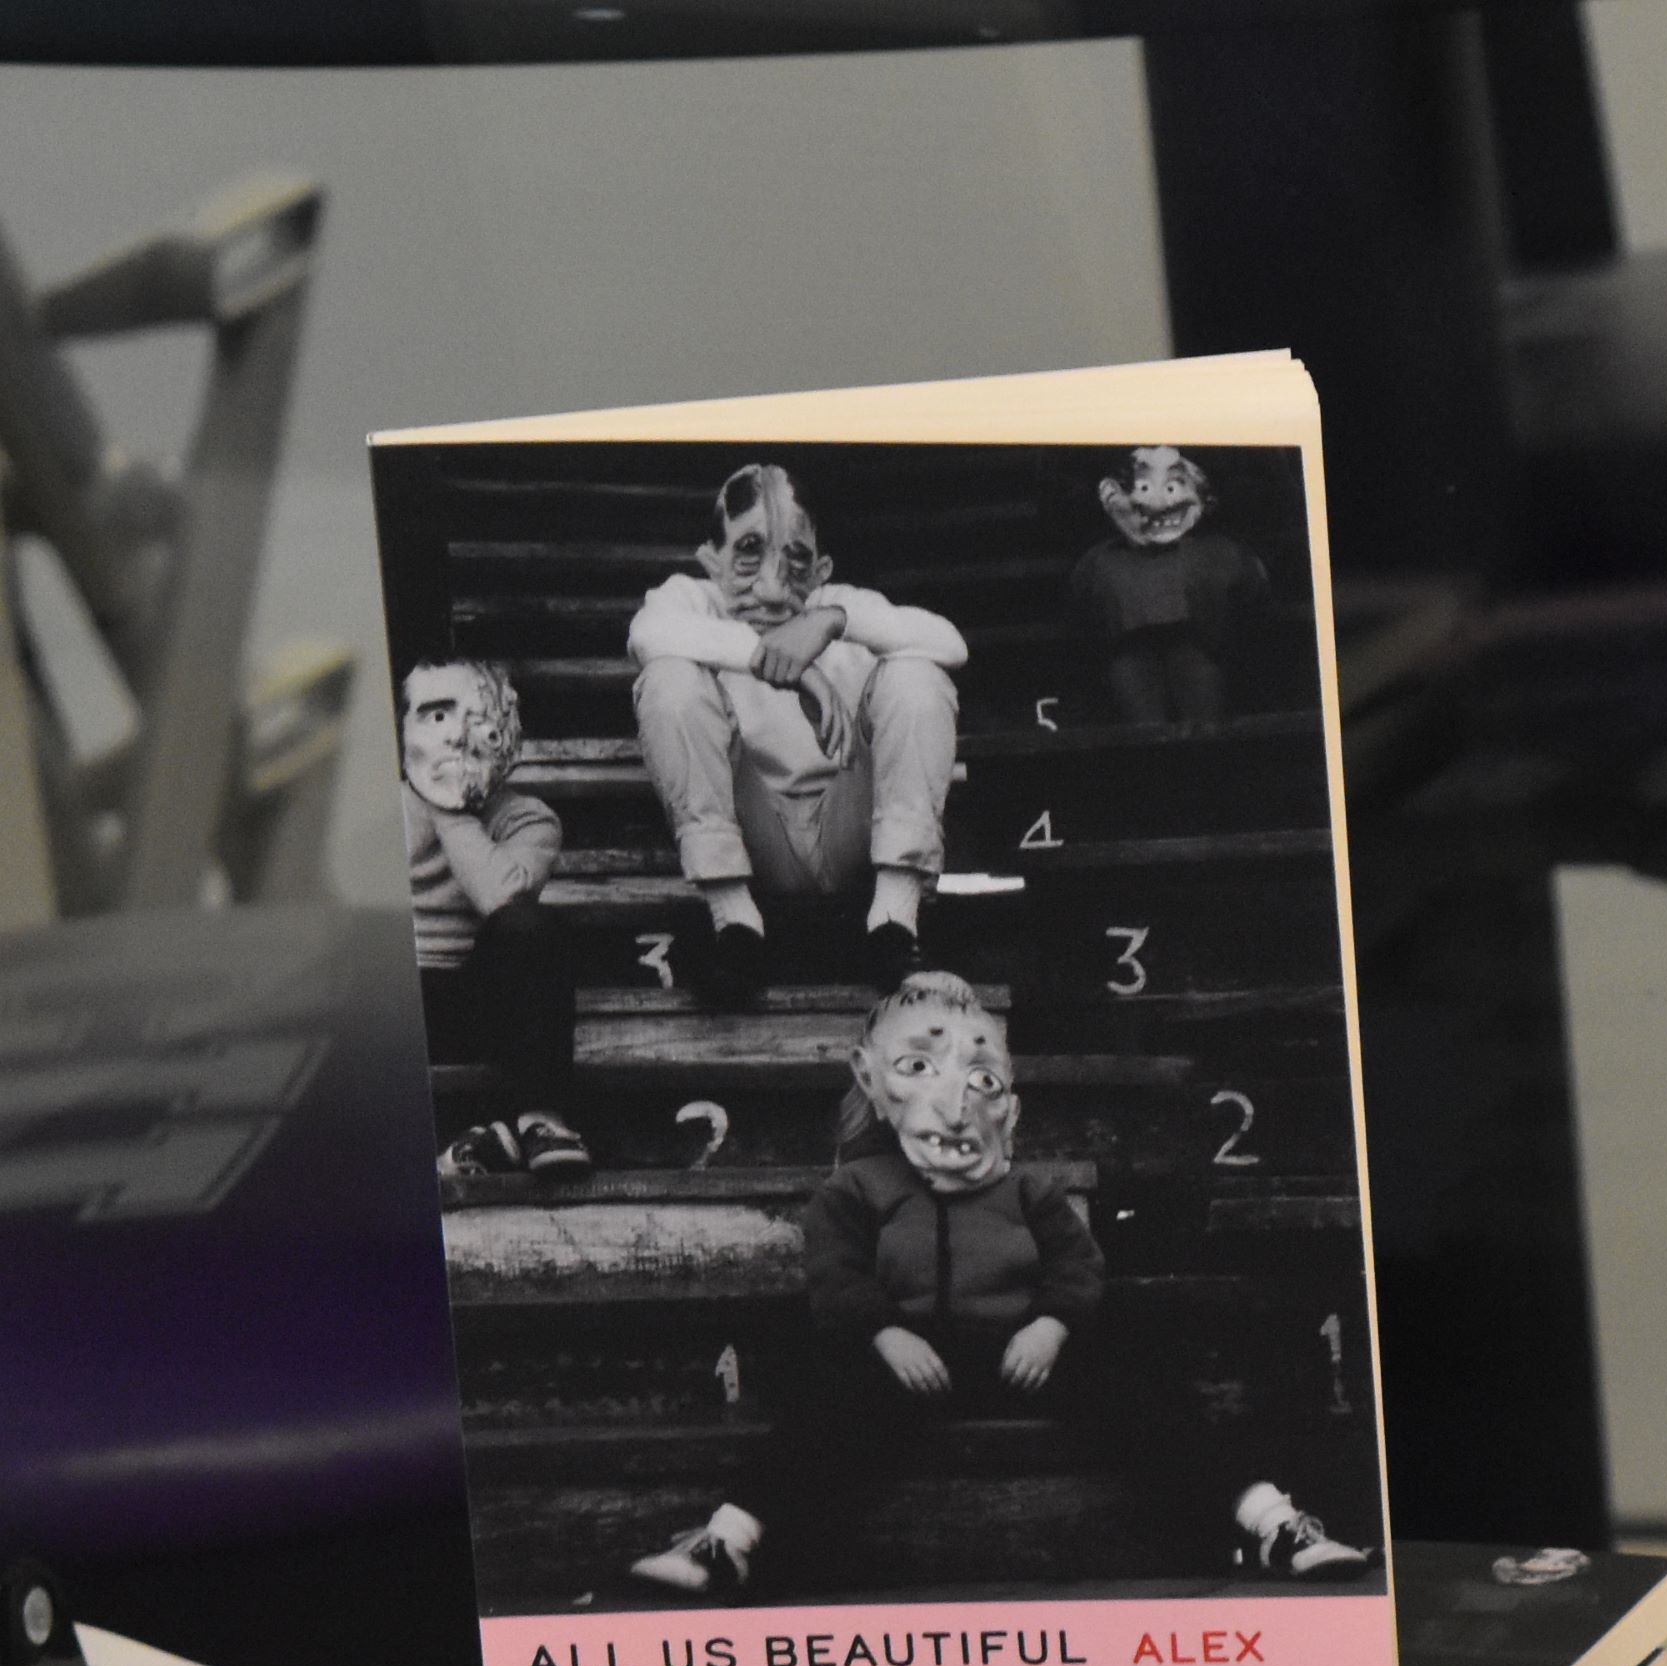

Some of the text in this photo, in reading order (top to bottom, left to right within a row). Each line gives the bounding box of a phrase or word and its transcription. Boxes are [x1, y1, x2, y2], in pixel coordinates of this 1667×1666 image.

[1105, 926, 1149, 995] 3
[1210, 1090, 1260, 1166] 2
[1132, 1630, 1265, 1665] ALEX
